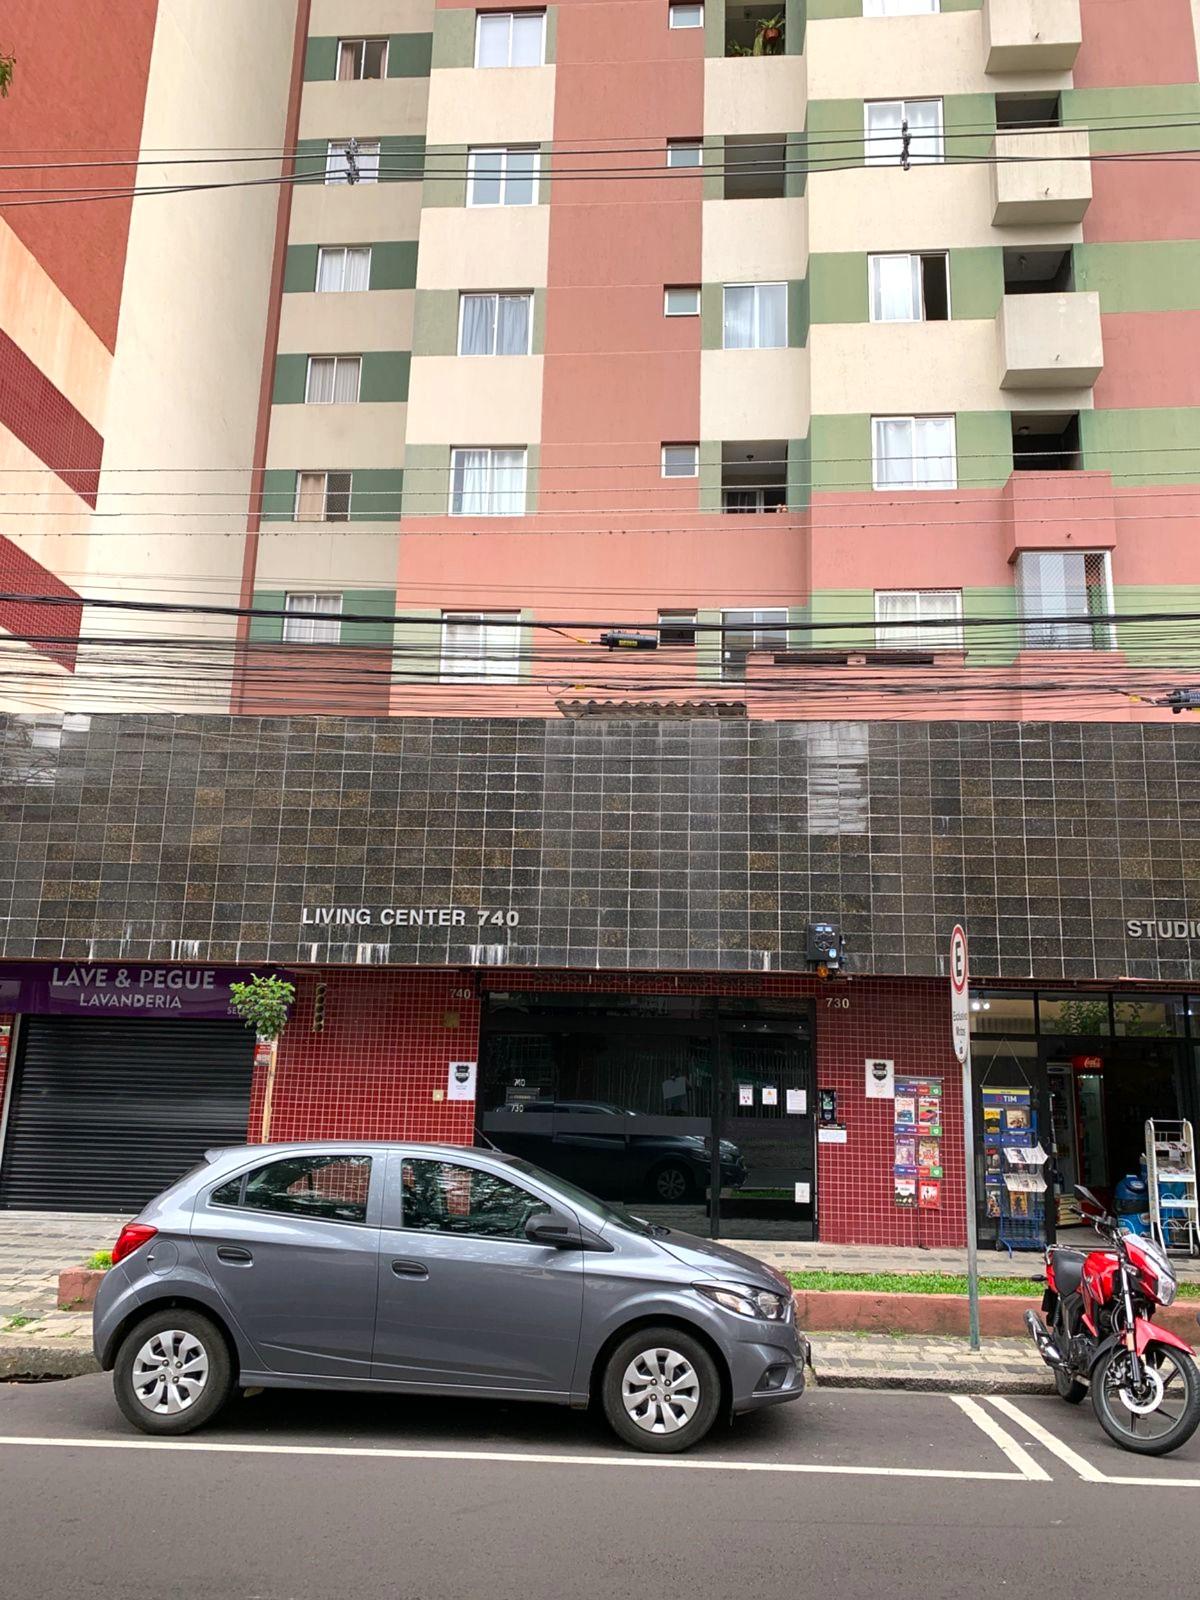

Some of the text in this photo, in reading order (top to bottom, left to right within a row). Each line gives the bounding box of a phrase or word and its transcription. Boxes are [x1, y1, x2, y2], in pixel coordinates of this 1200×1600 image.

[302, 907, 520, 927] LIVING CENTER 740
[955, 941, 963, 977] E
[52, 968, 215, 989] LAVE & PEGUE
[79, 993, 182, 1009] LAVANDERIA
[449, 988, 471, 999] 740
[826, 998, 850, 1009] 730
[1003, 1095, 1017, 1103] TIM
